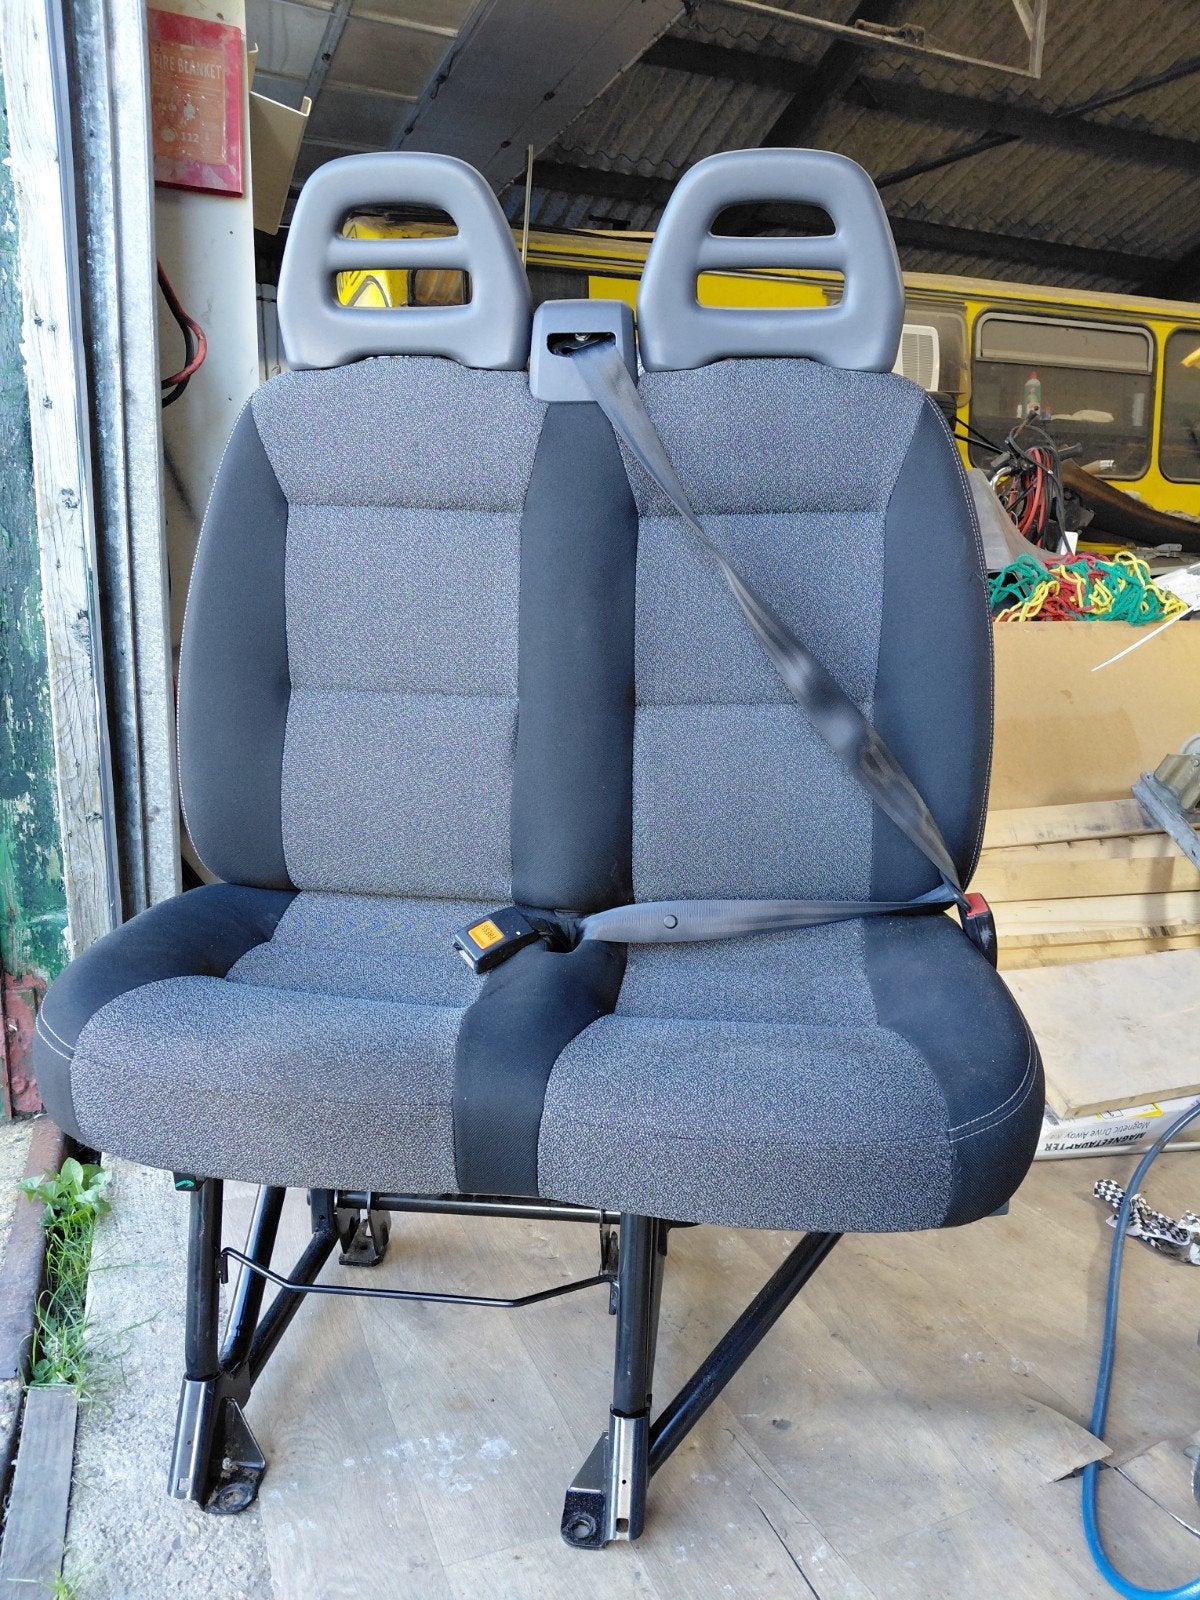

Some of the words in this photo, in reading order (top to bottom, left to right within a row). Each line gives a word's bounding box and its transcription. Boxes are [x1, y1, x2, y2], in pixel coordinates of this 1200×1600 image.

[153, 55, 177, 71] FIRE
[178, 57, 223, 79] BLANKET
[181, 131, 199, 142] 112
[1114, 1121, 1151, 1132] Magnetic
[1064, 1130, 1089, 1140] Away
[1089, 1128, 1112, 1138] Drive
